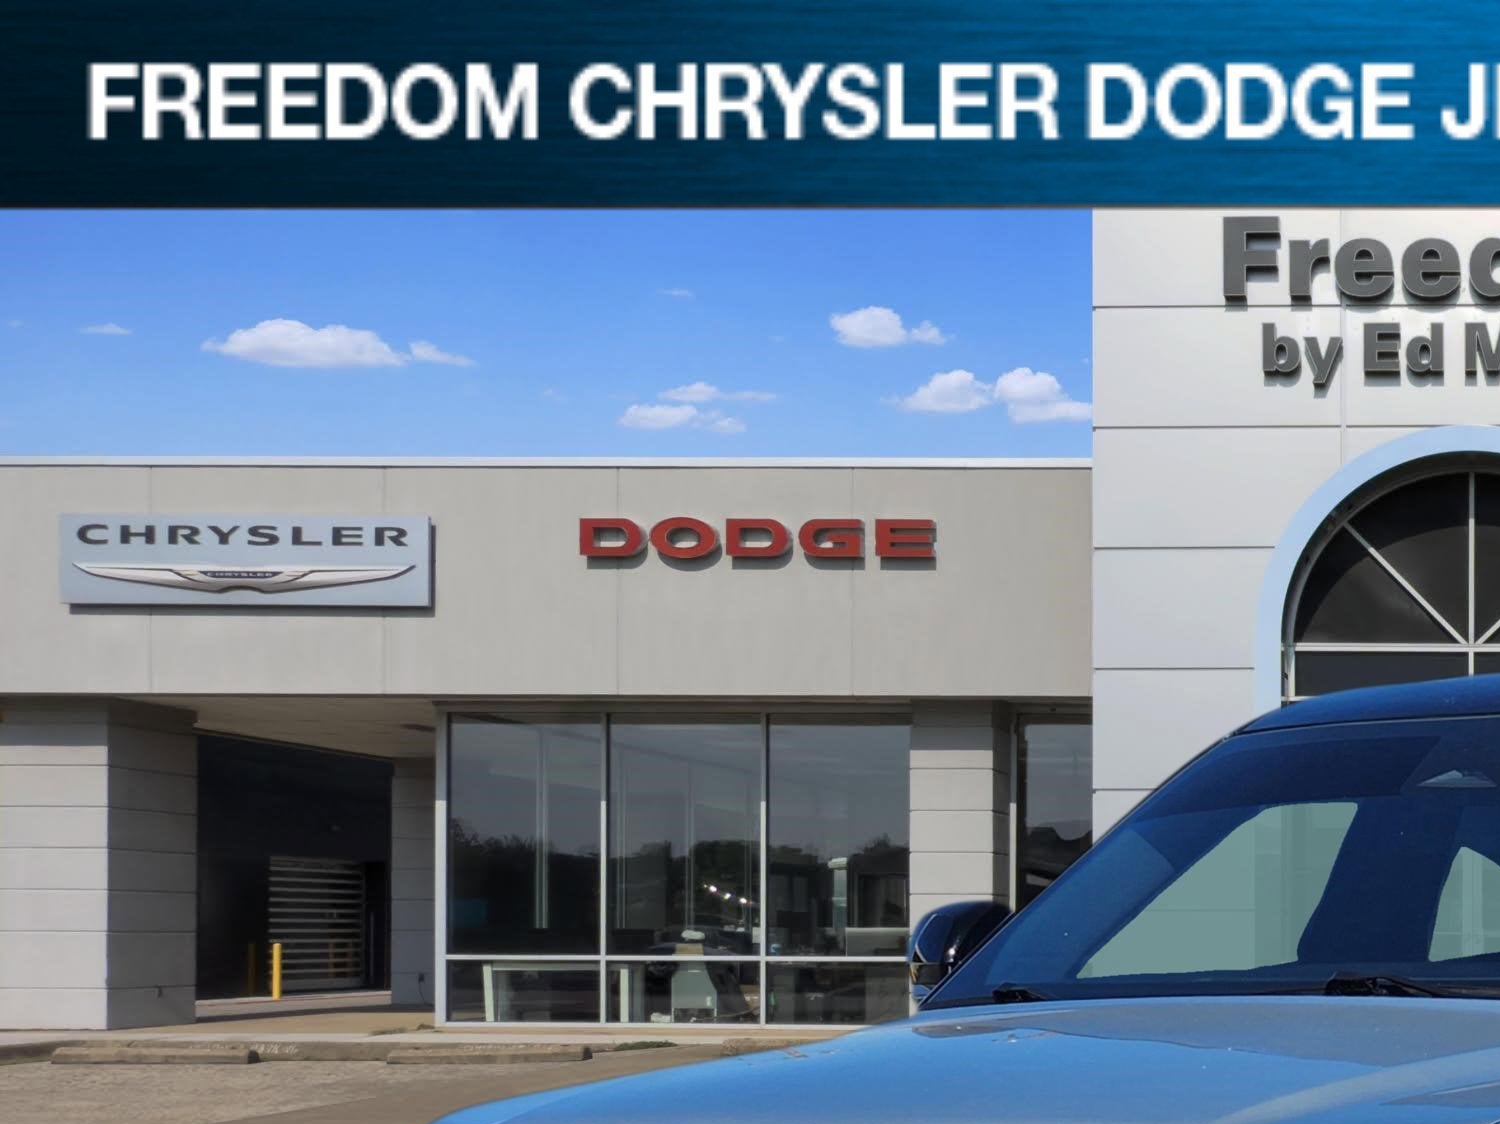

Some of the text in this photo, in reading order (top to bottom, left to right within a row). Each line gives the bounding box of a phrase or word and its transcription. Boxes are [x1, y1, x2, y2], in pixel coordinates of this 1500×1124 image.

[1262, 322, 1343, 389] by
[1363, 322, 1445, 376] Ed
[76, 523, 409, 547] CHRYSLER
[579, 517, 936, 562] DODGE
